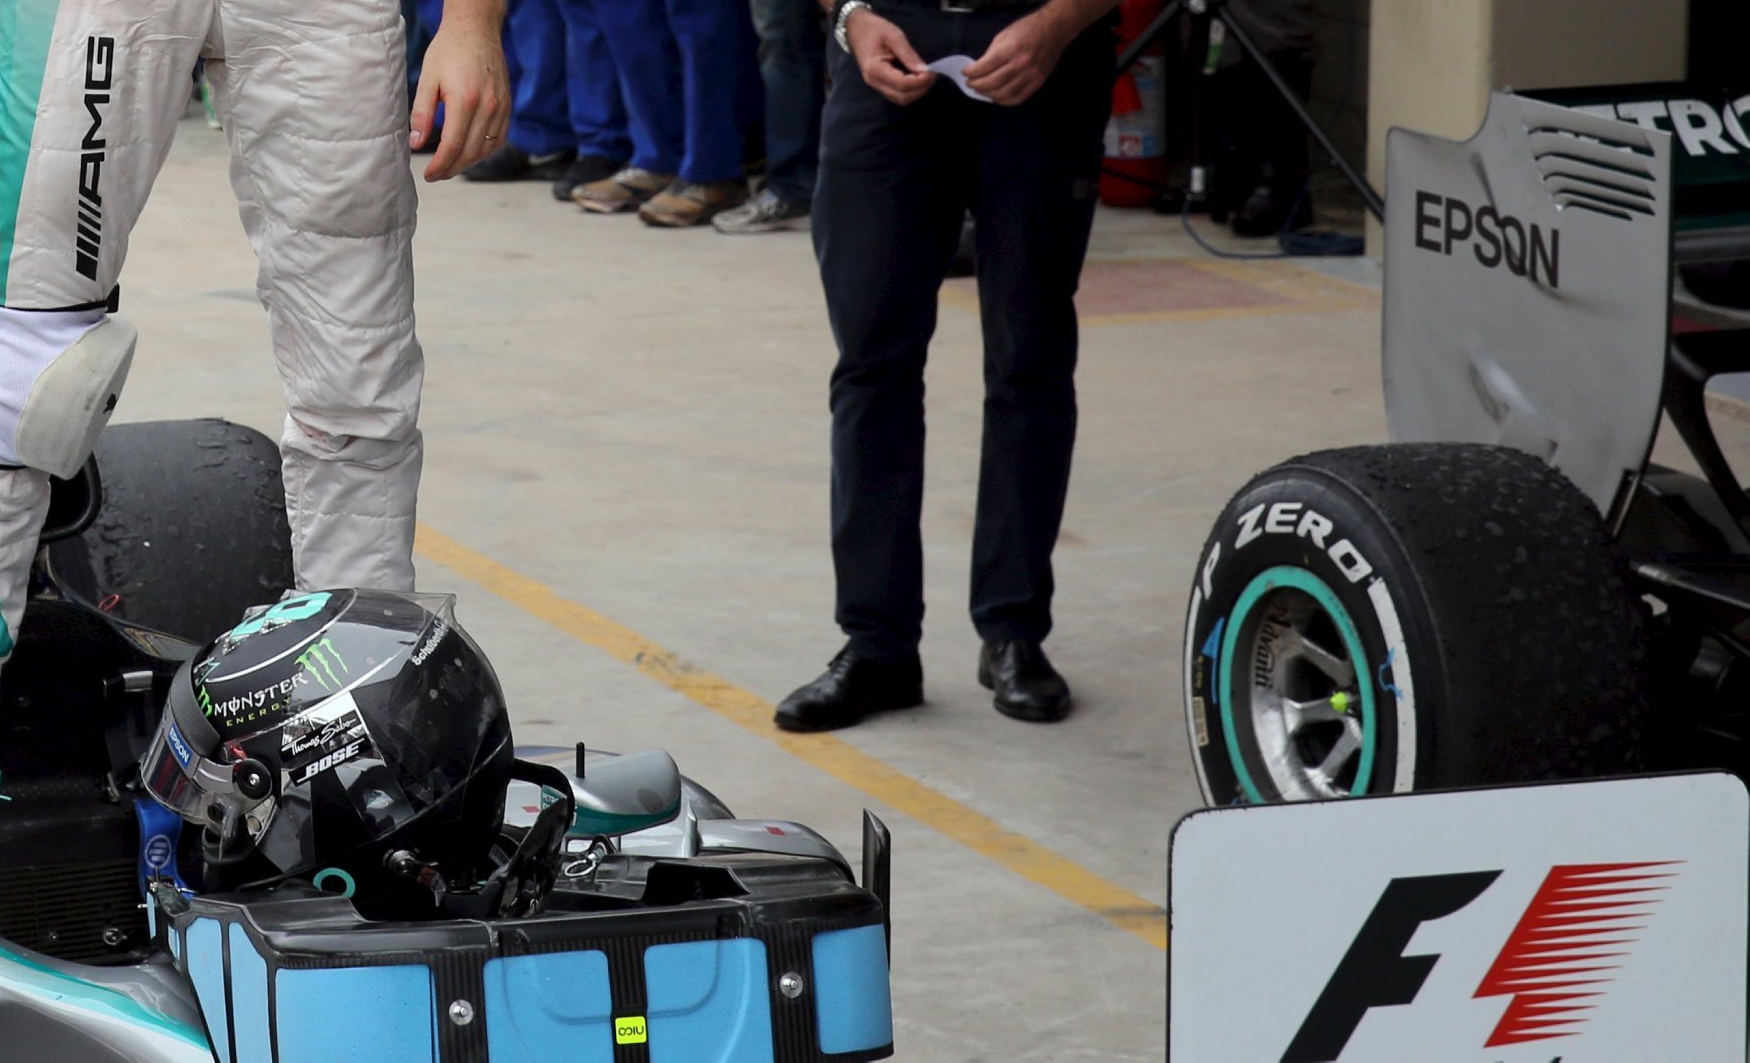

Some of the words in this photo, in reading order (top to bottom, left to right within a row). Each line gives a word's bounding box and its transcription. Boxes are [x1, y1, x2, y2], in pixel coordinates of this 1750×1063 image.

[78, 35, 114, 207] AMG
[1415, 189, 1560, 288] EPSON
[1234, 502, 1373, 584] ZERO
[214, 672, 309, 717] MONSTER
[226, 697, 291, 727] ENERGY
[167, 727, 190, 764] EPSON
[301, 741, 362, 781] BOSE
